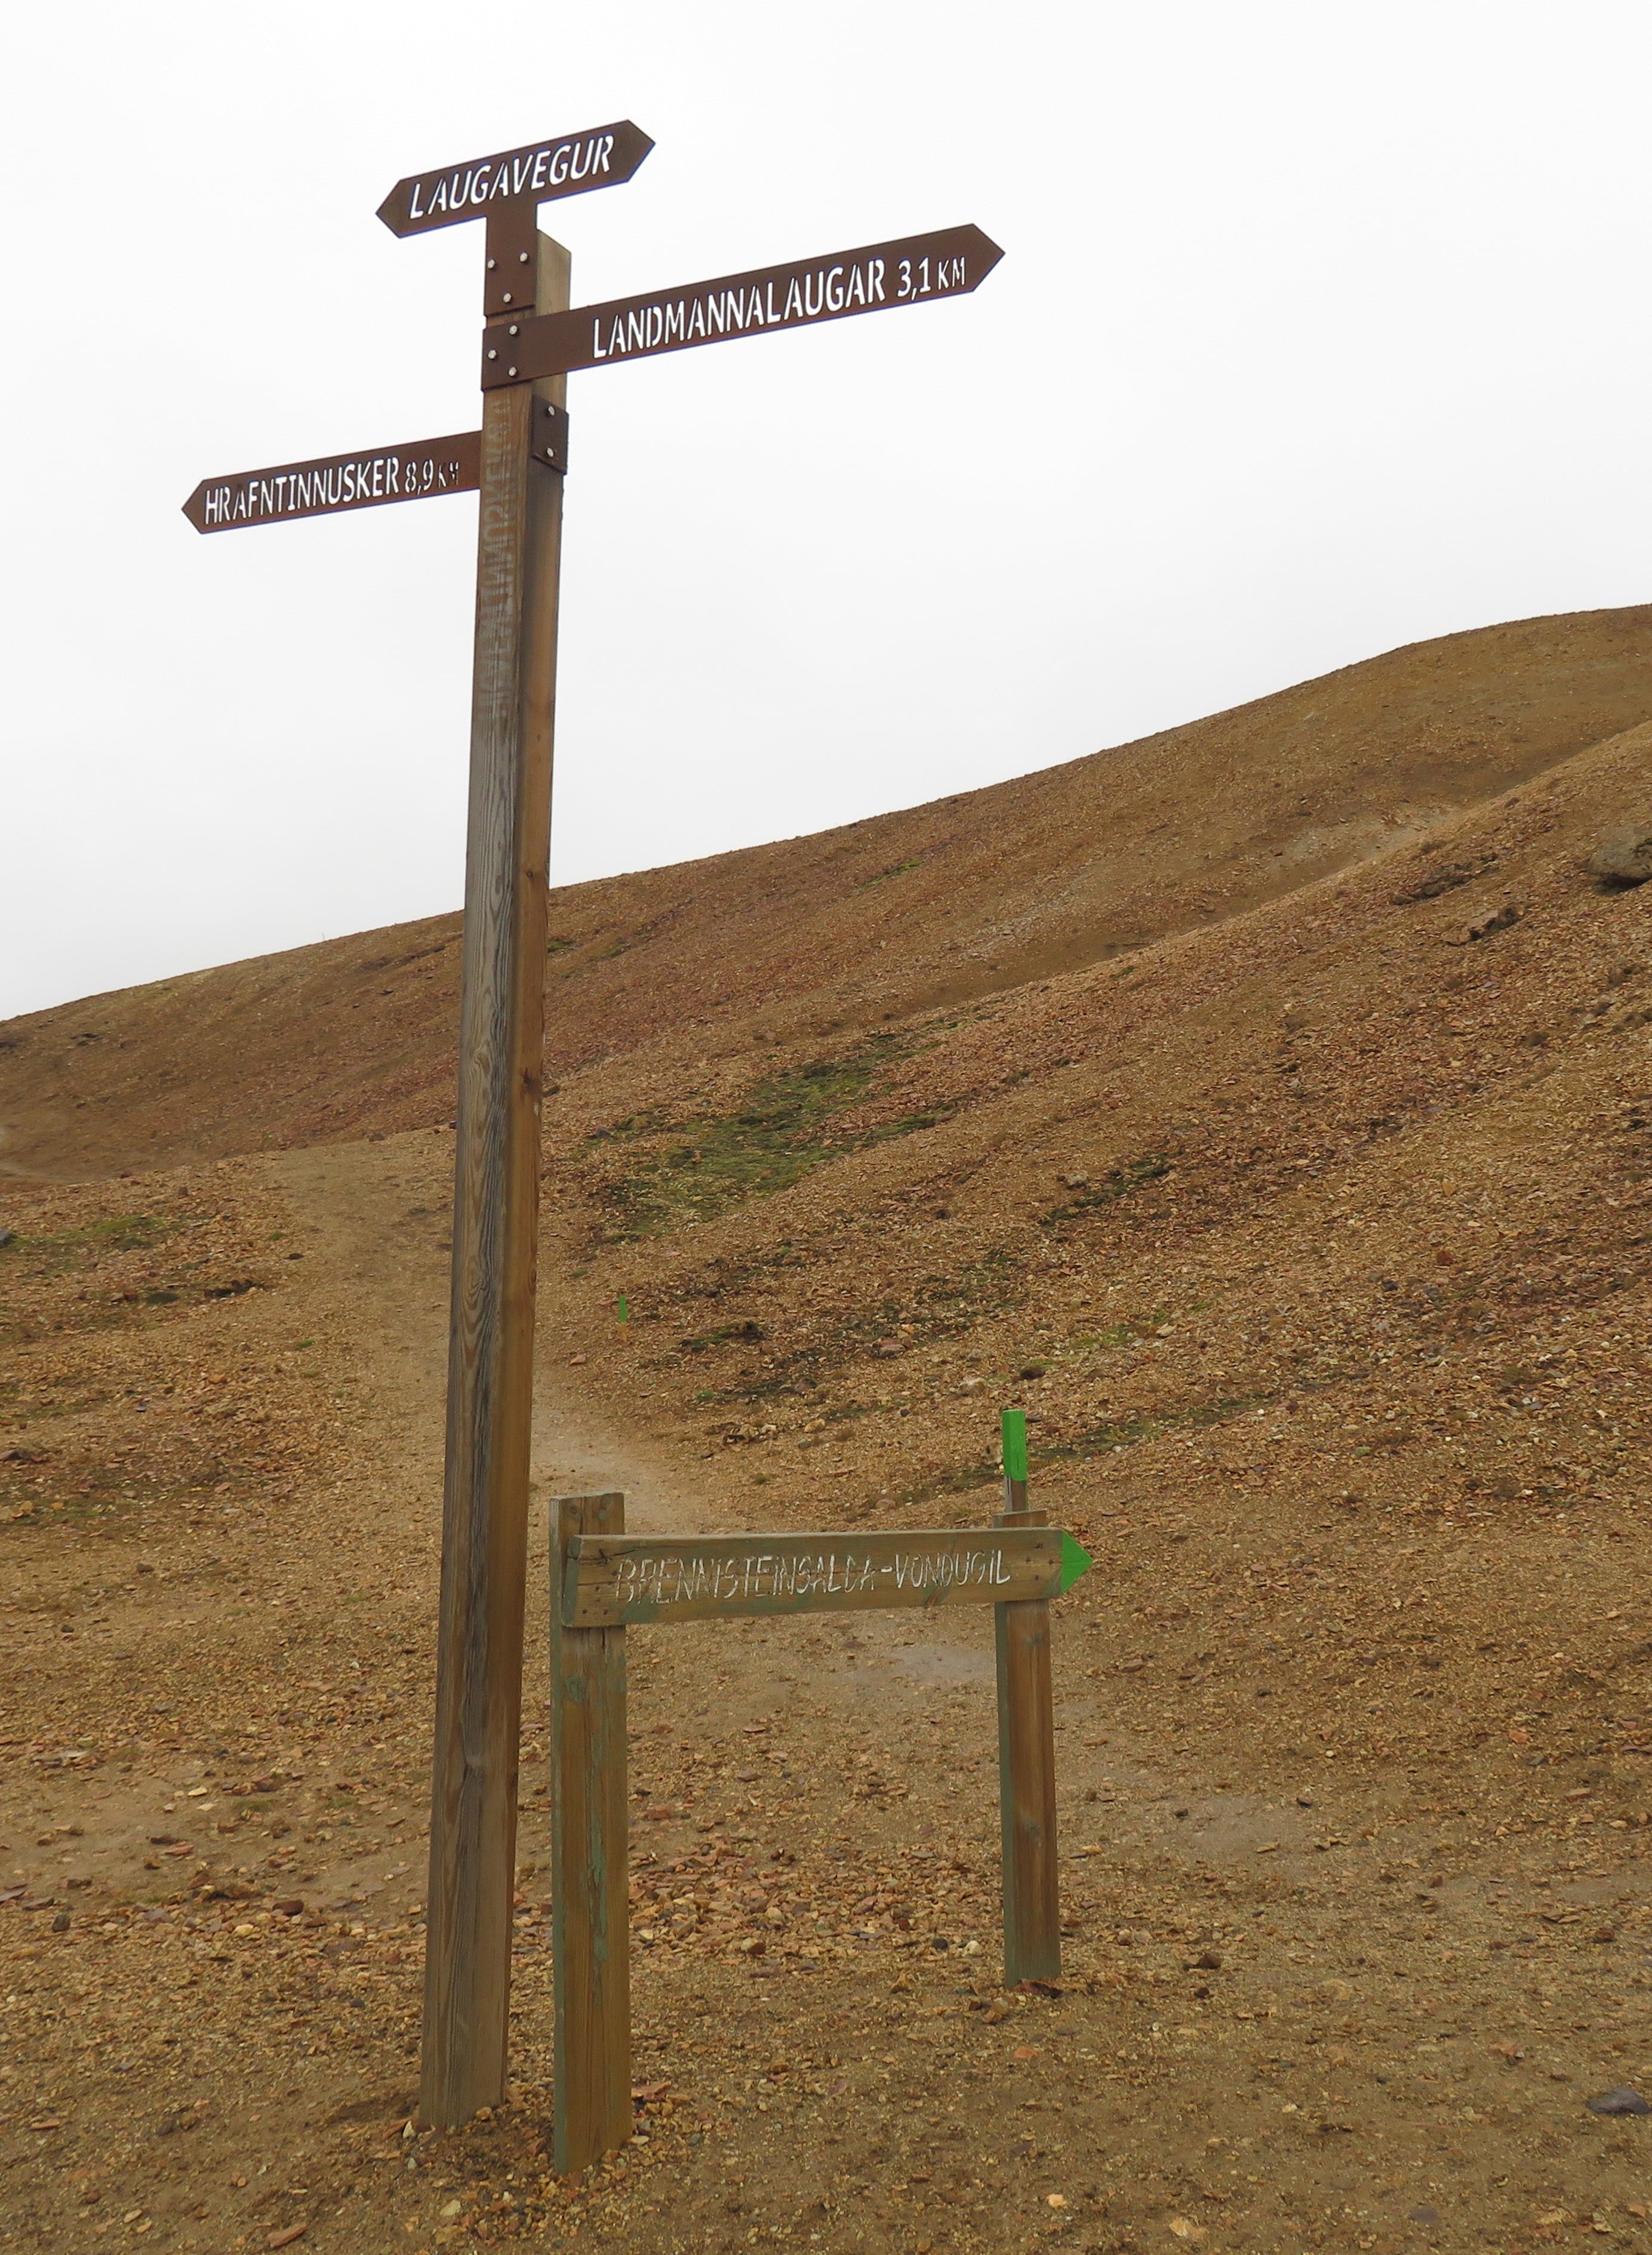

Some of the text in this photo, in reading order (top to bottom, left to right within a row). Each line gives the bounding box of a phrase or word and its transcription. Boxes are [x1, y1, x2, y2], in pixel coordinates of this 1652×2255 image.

[410, 135, 614, 220] LAUGAVEGUR
[593, 256, 965, 359] LANDMANNALAUGAR 3,1 KM
[205, 457, 399, 525] HRAFNTINNUSKER
[404, 459, 434, 496] 8,9
